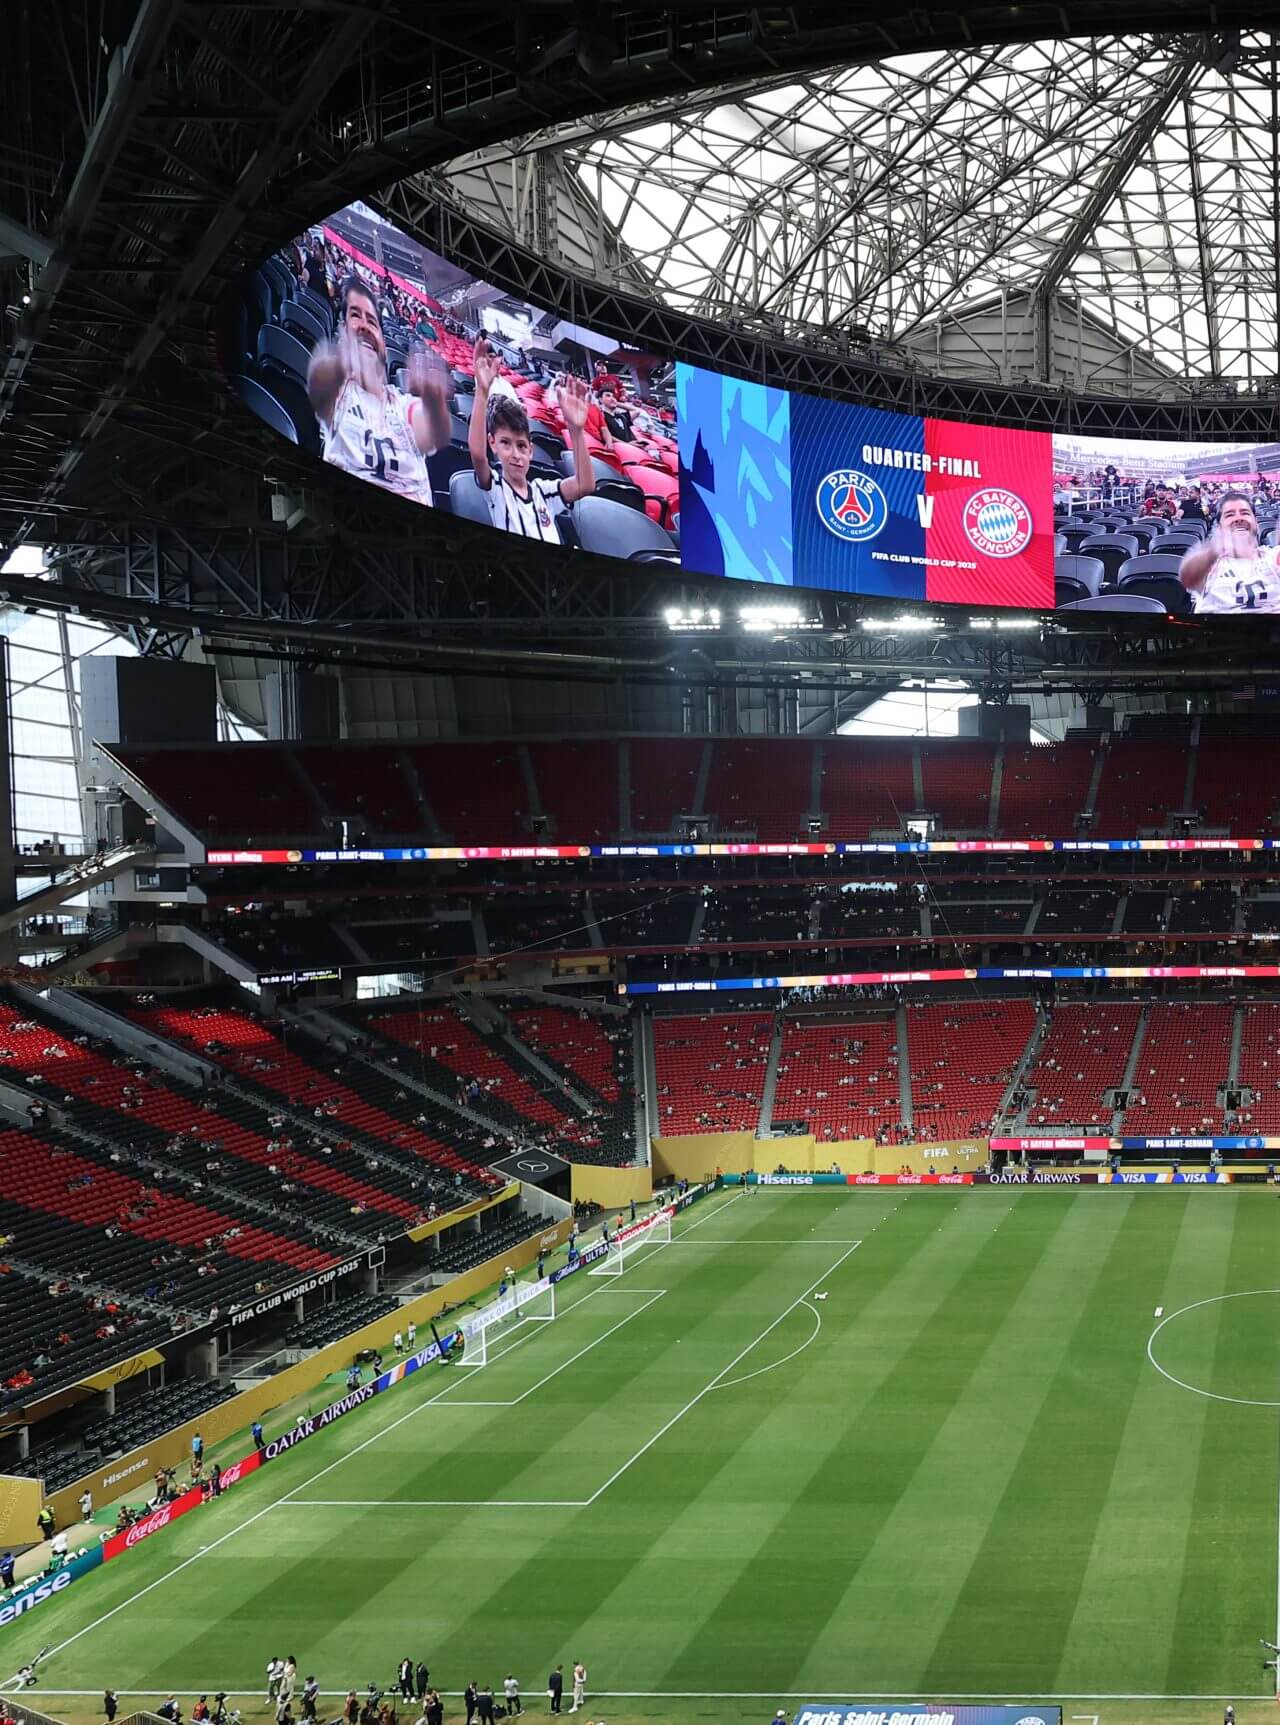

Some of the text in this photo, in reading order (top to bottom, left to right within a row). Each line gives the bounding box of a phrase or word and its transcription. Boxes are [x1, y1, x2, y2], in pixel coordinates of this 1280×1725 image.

[862, 445, 981, 478] QUARTER-FINAL
[827, 474, 876, 495] PARIS
[916, 494, 934, 528] V
[968, 493, 1027, 520] FC BAYERN
[969, 527, 1027, 554] MÜNCHEN
[872, 552, 977, 569] FIFA CLUB WORLD CUP 2025
[924, 1147, 949, 1158] FIFA
[757, 1174, 813, 1185] Hisense
[990, 1174, 1081, 1184] QATAR AIRWAYS
[1122, 1174, 1146, 1183] VISA
[1183, 1174, 1207, 1183] VISA
[585, 1245, 609, 1263] ULTRA
[232, 1259, 360, 1327] FIFA CLUB WORLD CUP 2025
[415, 1344, 441, 1368] VISA
[265, 1386, 374, 1459] QATAR AIRWAYS
[104, 1457, 148, 1487] Hisense
[126, 1505, 173, 1547] Coca-Cola
[800, 1711, 955, 1725] Paris Saint-Germain
